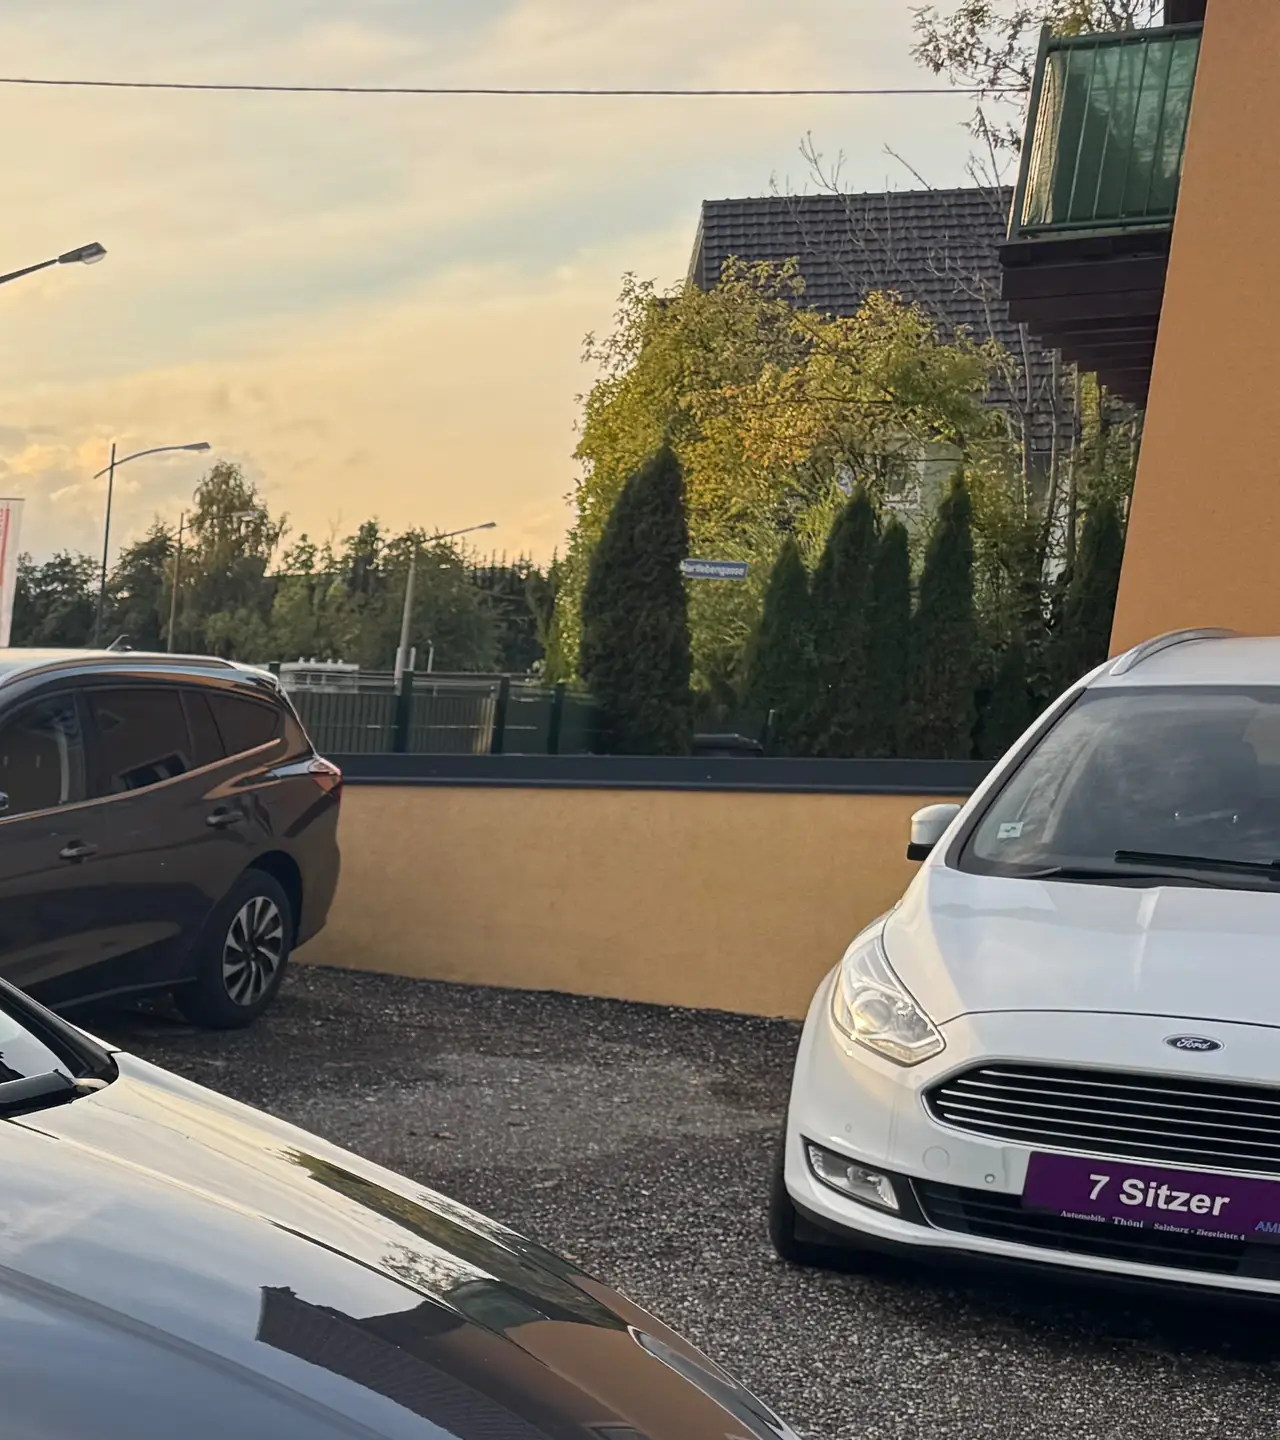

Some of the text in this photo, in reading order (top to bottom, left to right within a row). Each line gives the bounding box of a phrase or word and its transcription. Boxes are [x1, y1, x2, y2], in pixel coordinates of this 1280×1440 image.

[1088, 1172, 1231, 1217] 7 Sitzer
[1153, 1222, 1189, 1235] Salzburg
